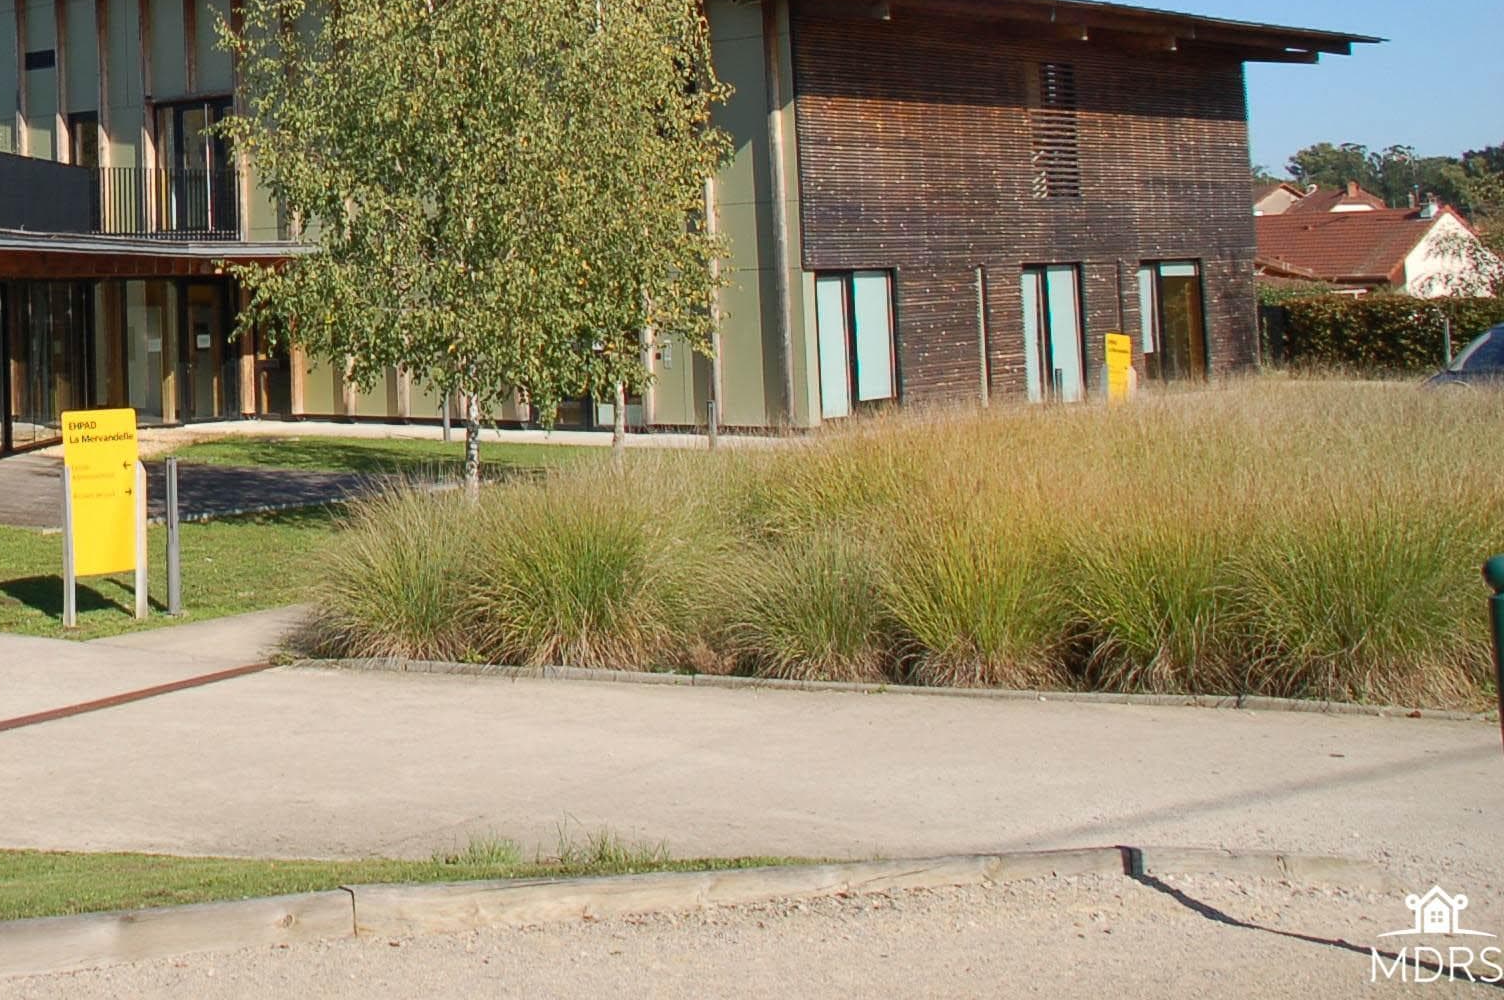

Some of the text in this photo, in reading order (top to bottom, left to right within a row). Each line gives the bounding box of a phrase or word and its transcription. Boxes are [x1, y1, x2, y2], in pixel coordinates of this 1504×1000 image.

[68, 421, 97, 430] EHPAD
[69, 432, 134, 443] La Mervandelle
